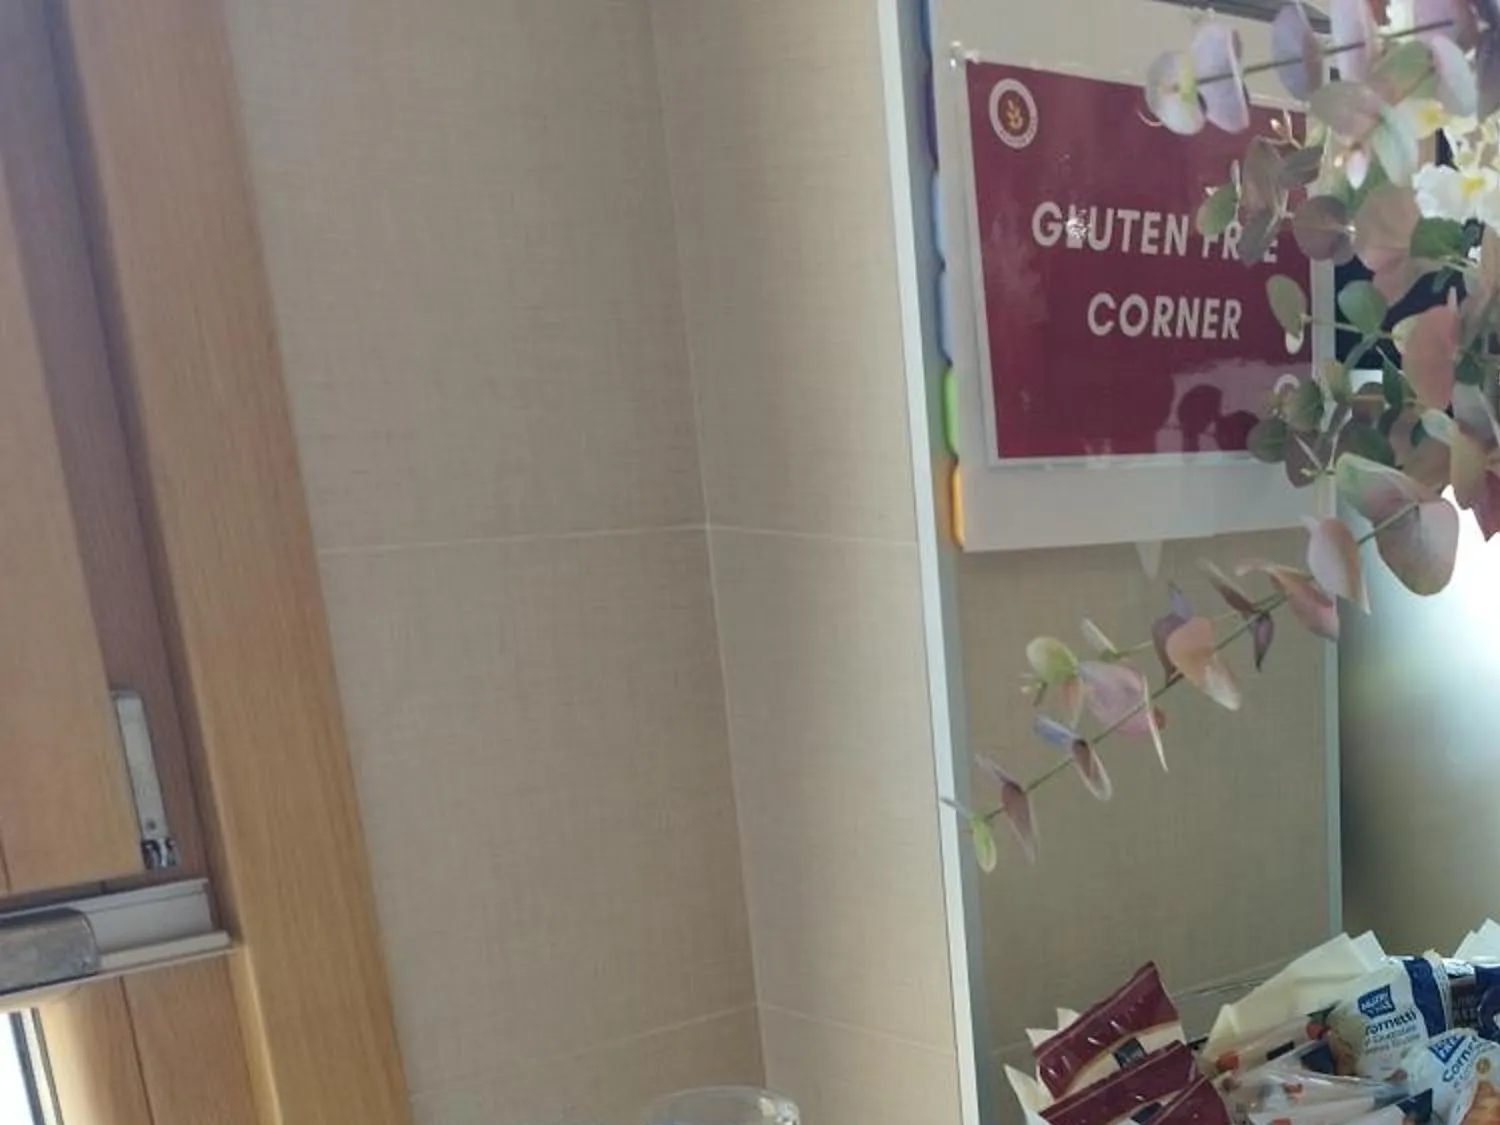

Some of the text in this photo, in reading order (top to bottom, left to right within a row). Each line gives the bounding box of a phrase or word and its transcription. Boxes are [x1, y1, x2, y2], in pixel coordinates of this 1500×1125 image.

[1031, 201, 1279, 263] GLUTEN FRE
[1087, 292, 1243, 340] CORNER
